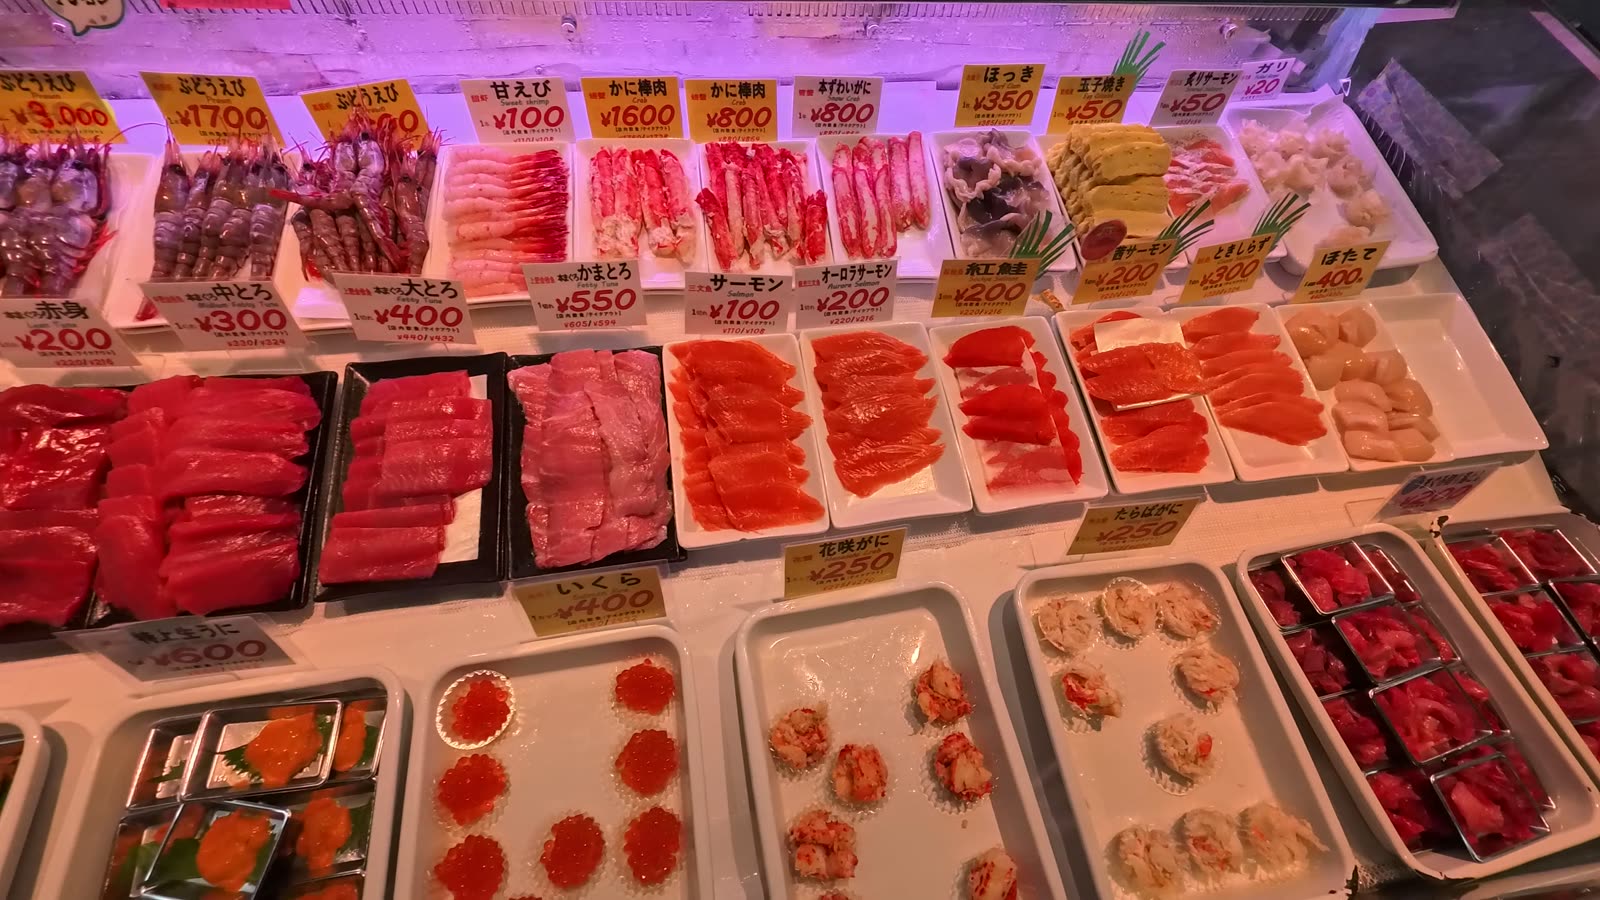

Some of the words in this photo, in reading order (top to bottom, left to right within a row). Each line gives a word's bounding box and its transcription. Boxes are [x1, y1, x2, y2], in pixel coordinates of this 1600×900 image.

[983, 66, 1034, 82] ほっき
[1256, 62, 1288, 74] ガリ
[178, 76, 246, 97] ぶどうえび
[609, 79, 667, 96] かに棒肉
[818, 79, 871, 95] 本ずわいがに
[1077, 76, 1125, 92] 玉子焼き
[1184, 71, 1238, 86] 炙りサーモン
[1245, 78, 1280, 95] ¥20
[490, 80, 551, 99] 甘えび
[711, 82, 766, 99] かに棒肉
[526, 98, 549, 106] shrimp
[973, 90, 1034, 111] ¥350
[1066, 99, 1123, 120] ¥50
[1170, 93, 1226, 112] ¥50
[176, 104, 268, 129] ¥1700
[493, 106, 564, 129] ¥100
[600, 104, 675, 127] ¥1600
[707, 107, 772, 127] ¥800
[810, 103, 874, 123] ¥800
[1214, 236, 1271, 259] ときしらず
[1321, 248, 1377, 265] ほたて
[822, 264, 892, 283] オーロラサーモン
[965, 262, 1027, 276] 紅鮭
[1095, 263, 1158, 287] ¥200
[1200, 259, 1259, 286] ¥300
[710, 274, 783, 292] サーモン
[954, 282, 1026, 302] ¥200
[556, 288, 637, 313] ¥550
[817, 287, 889, 312] ¥200
[374, 304, 463, 327] ¥400
[709, 300, 780, 320] ¥100
[194, 309, 287, 332] ¥300
[15, 328, 111, 351] ¥200
[1114, 504, 1183, 520] たらばがに
[1096, 521, 1178, 542] ¥250
[819, 535, 889, 557] 花咲がに
[809, 552, 894, 581] ¥250
[556, 573, 641, 595] いくら
[557, 590, 654, 619] ¥400
[151, 640, 266, 666] ¥600
